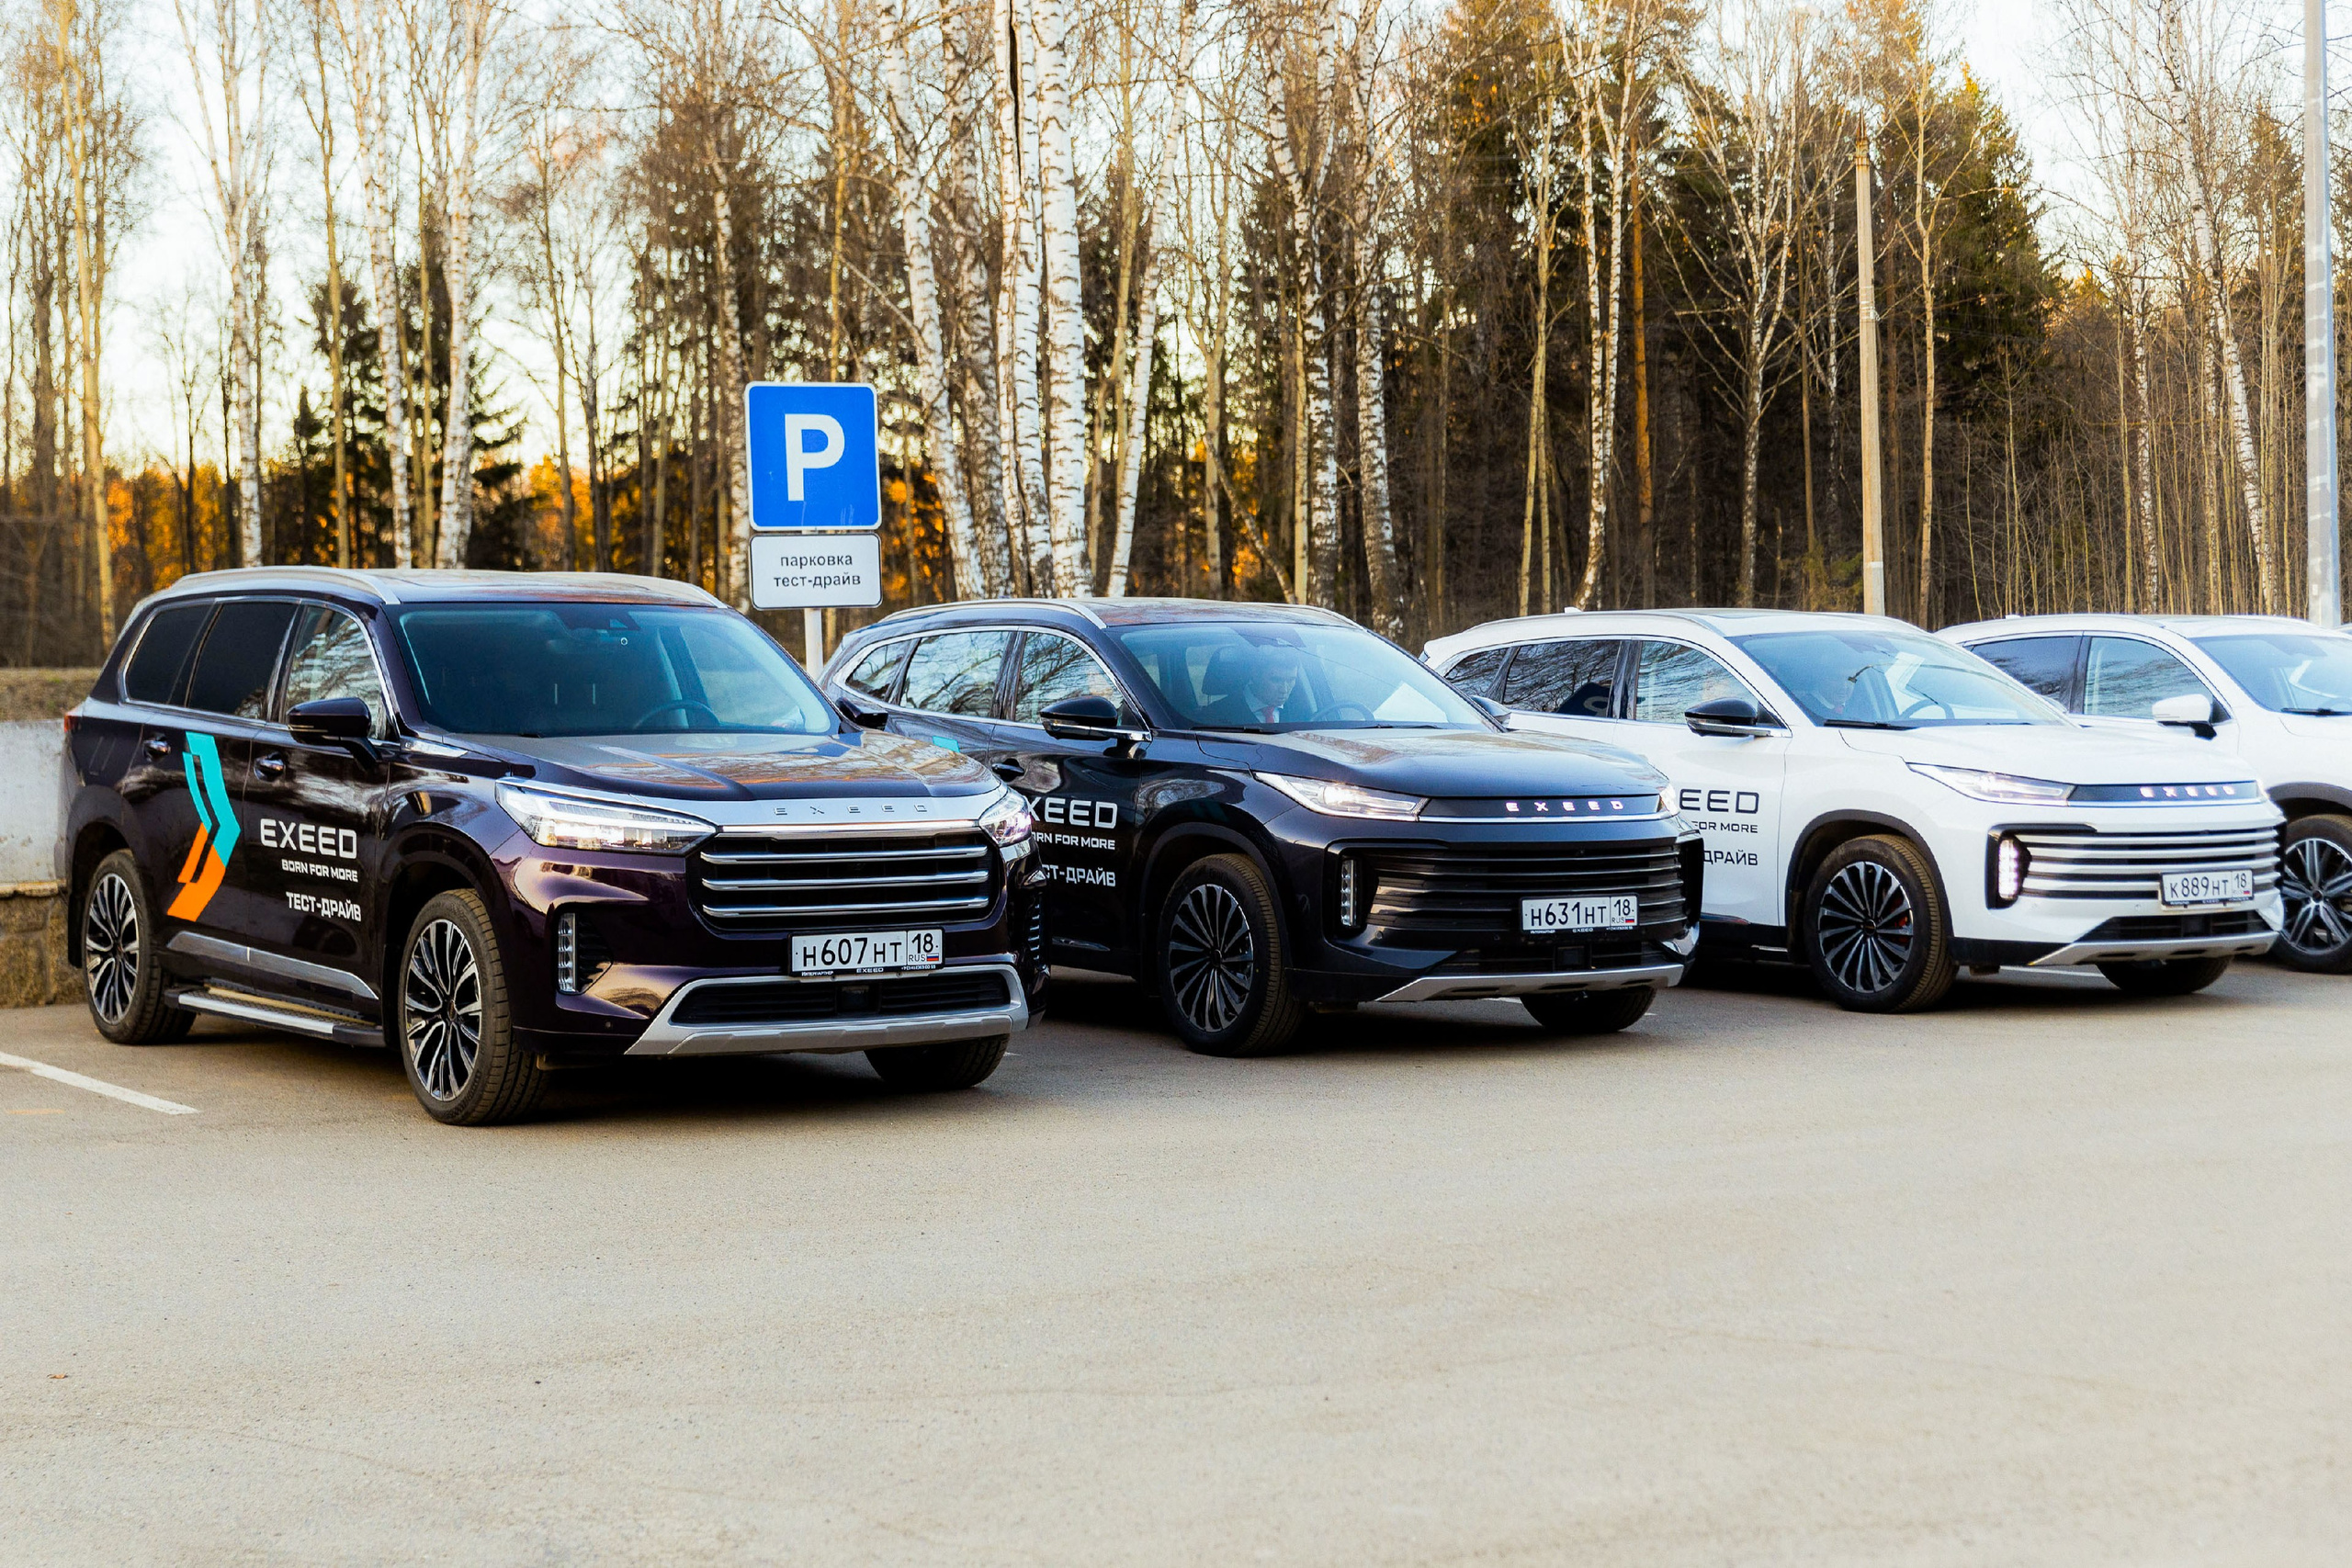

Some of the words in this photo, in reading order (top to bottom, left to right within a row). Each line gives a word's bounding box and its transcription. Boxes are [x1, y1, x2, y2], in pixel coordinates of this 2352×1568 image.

[785, 413, 845, 502] P
[781, 555, 853, 569] парковка
[774, 572, 861, 588] тест-драйв
[774, 804, 928, 816] EXEED
[1505, 800, 1624, 812] EXEED
[1679, 788, 1759, 814] EED
[1028, 796, 1118, 829] XEED
[1720, 822, 1758, 833] MORE
[260, 818, 357, 859] EXEED
[1031, 831, 1053, 844] RN
[1055, 834, 1079, 846] FOR
[1080, 837, 1115, 850] MORE
[281, 859, 309, 874] BORN
[309, 863, 330, 878] FOR
[330, 866, 359, 883] MORE
[1042, 863, 1115, 887] СТ-ДРАЙВ
[2234, 873, 2247, 889] 18
[286, 891, 362, 922] ТЕСТ-ДРАЙВ
[1614, 898, 1631, 917] 18
[911, 932, 933, 953] 18
[908, 953, 926, 962] RUS
